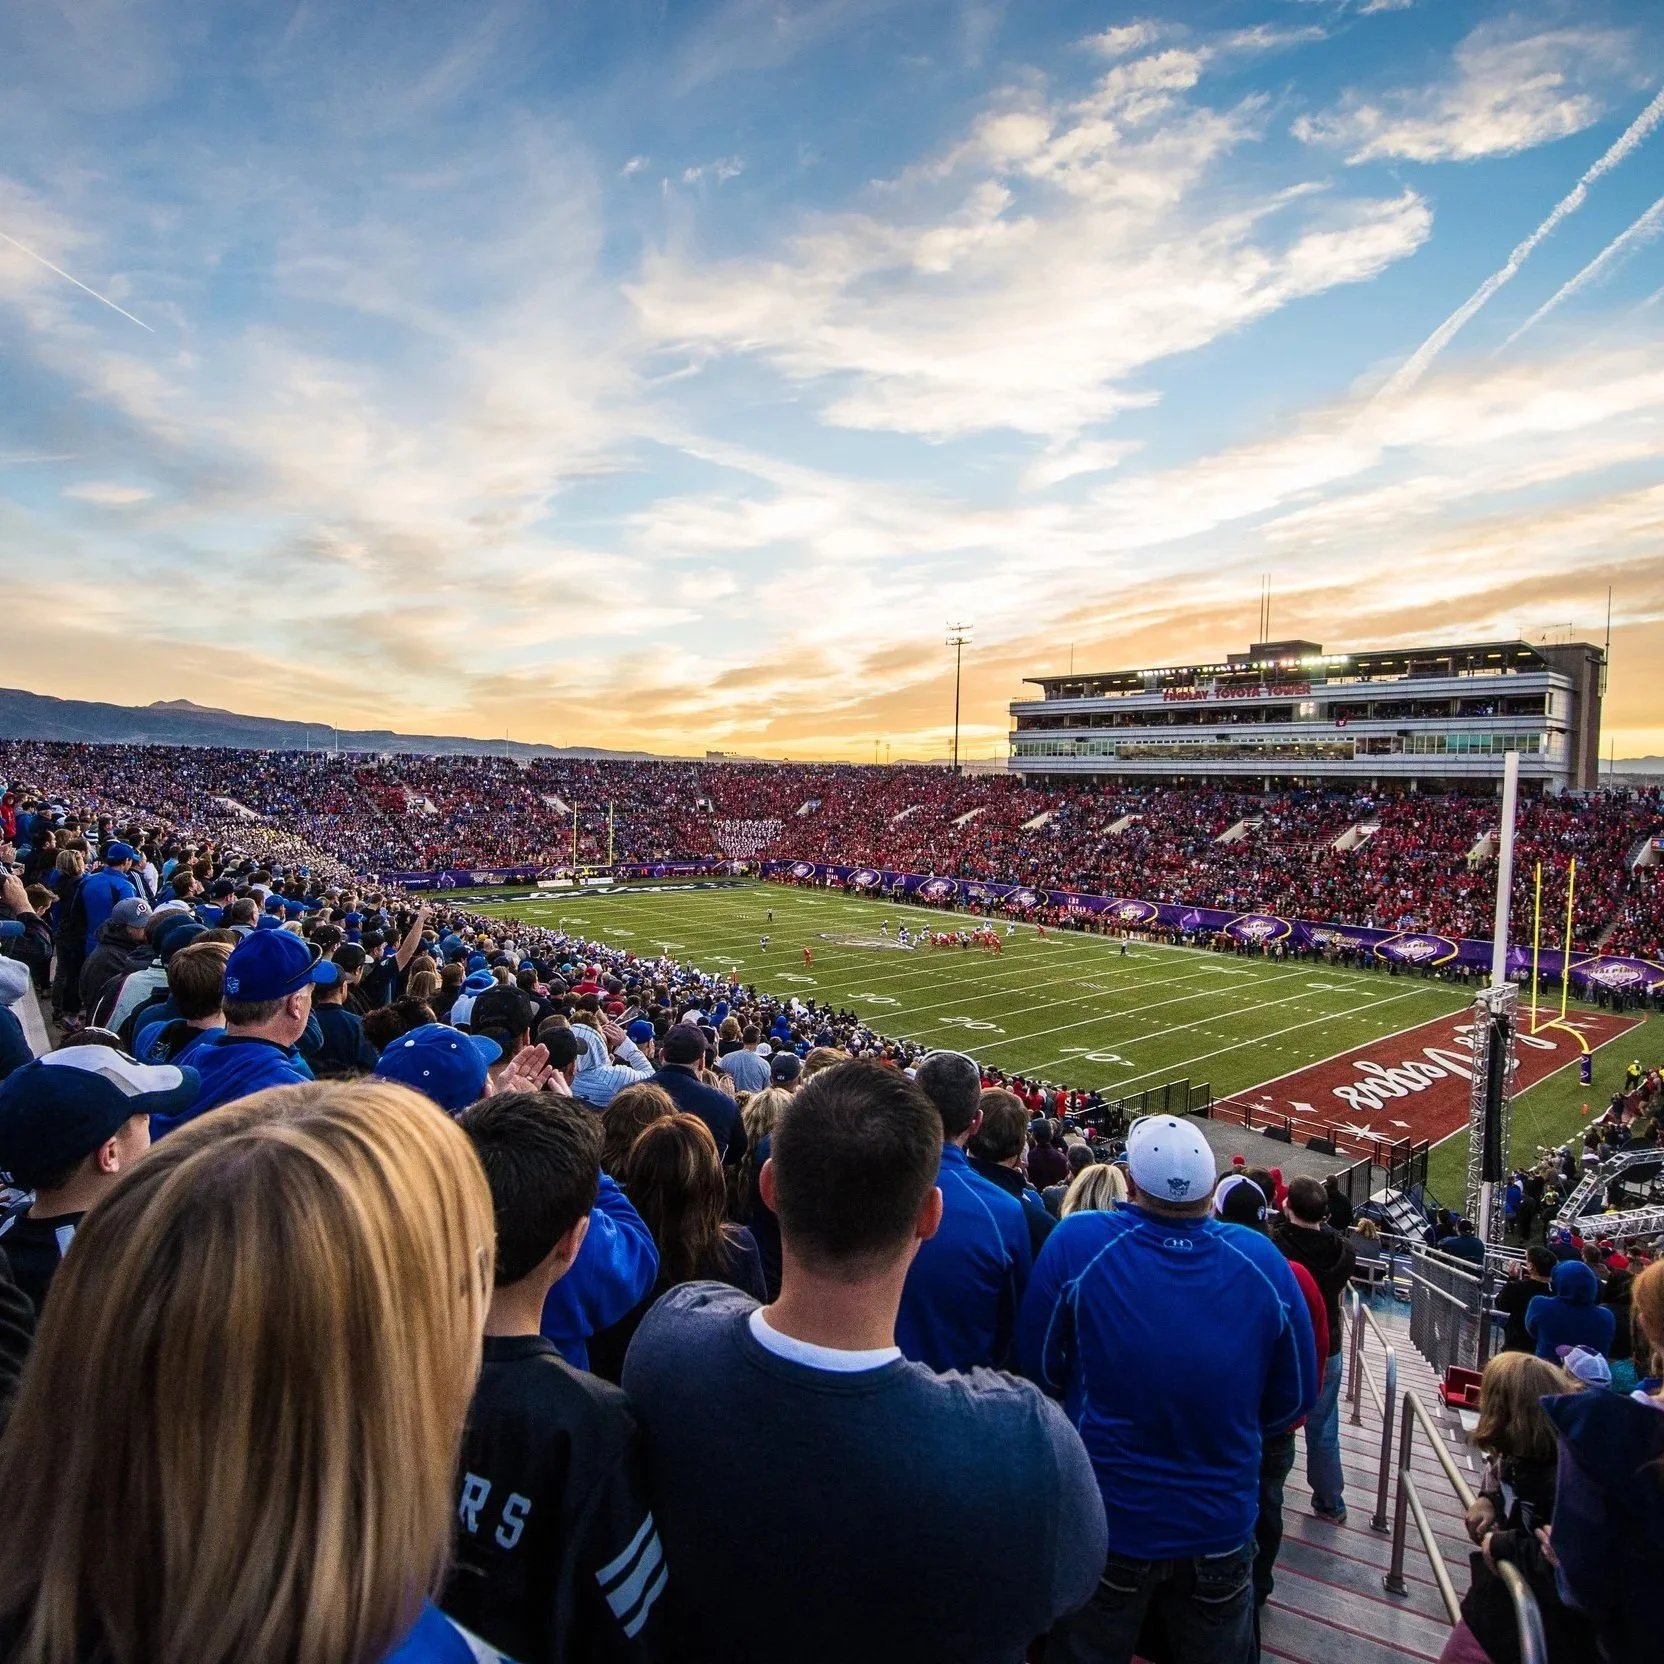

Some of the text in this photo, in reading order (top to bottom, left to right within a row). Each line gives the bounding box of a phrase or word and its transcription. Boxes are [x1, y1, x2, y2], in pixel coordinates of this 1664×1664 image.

[1163, 682, 1311, 701] FINDLAY TOYOTA TOWER
[938, 1016, 996, 1030] 20
[1059, 1047, 1121, 1062] 10
